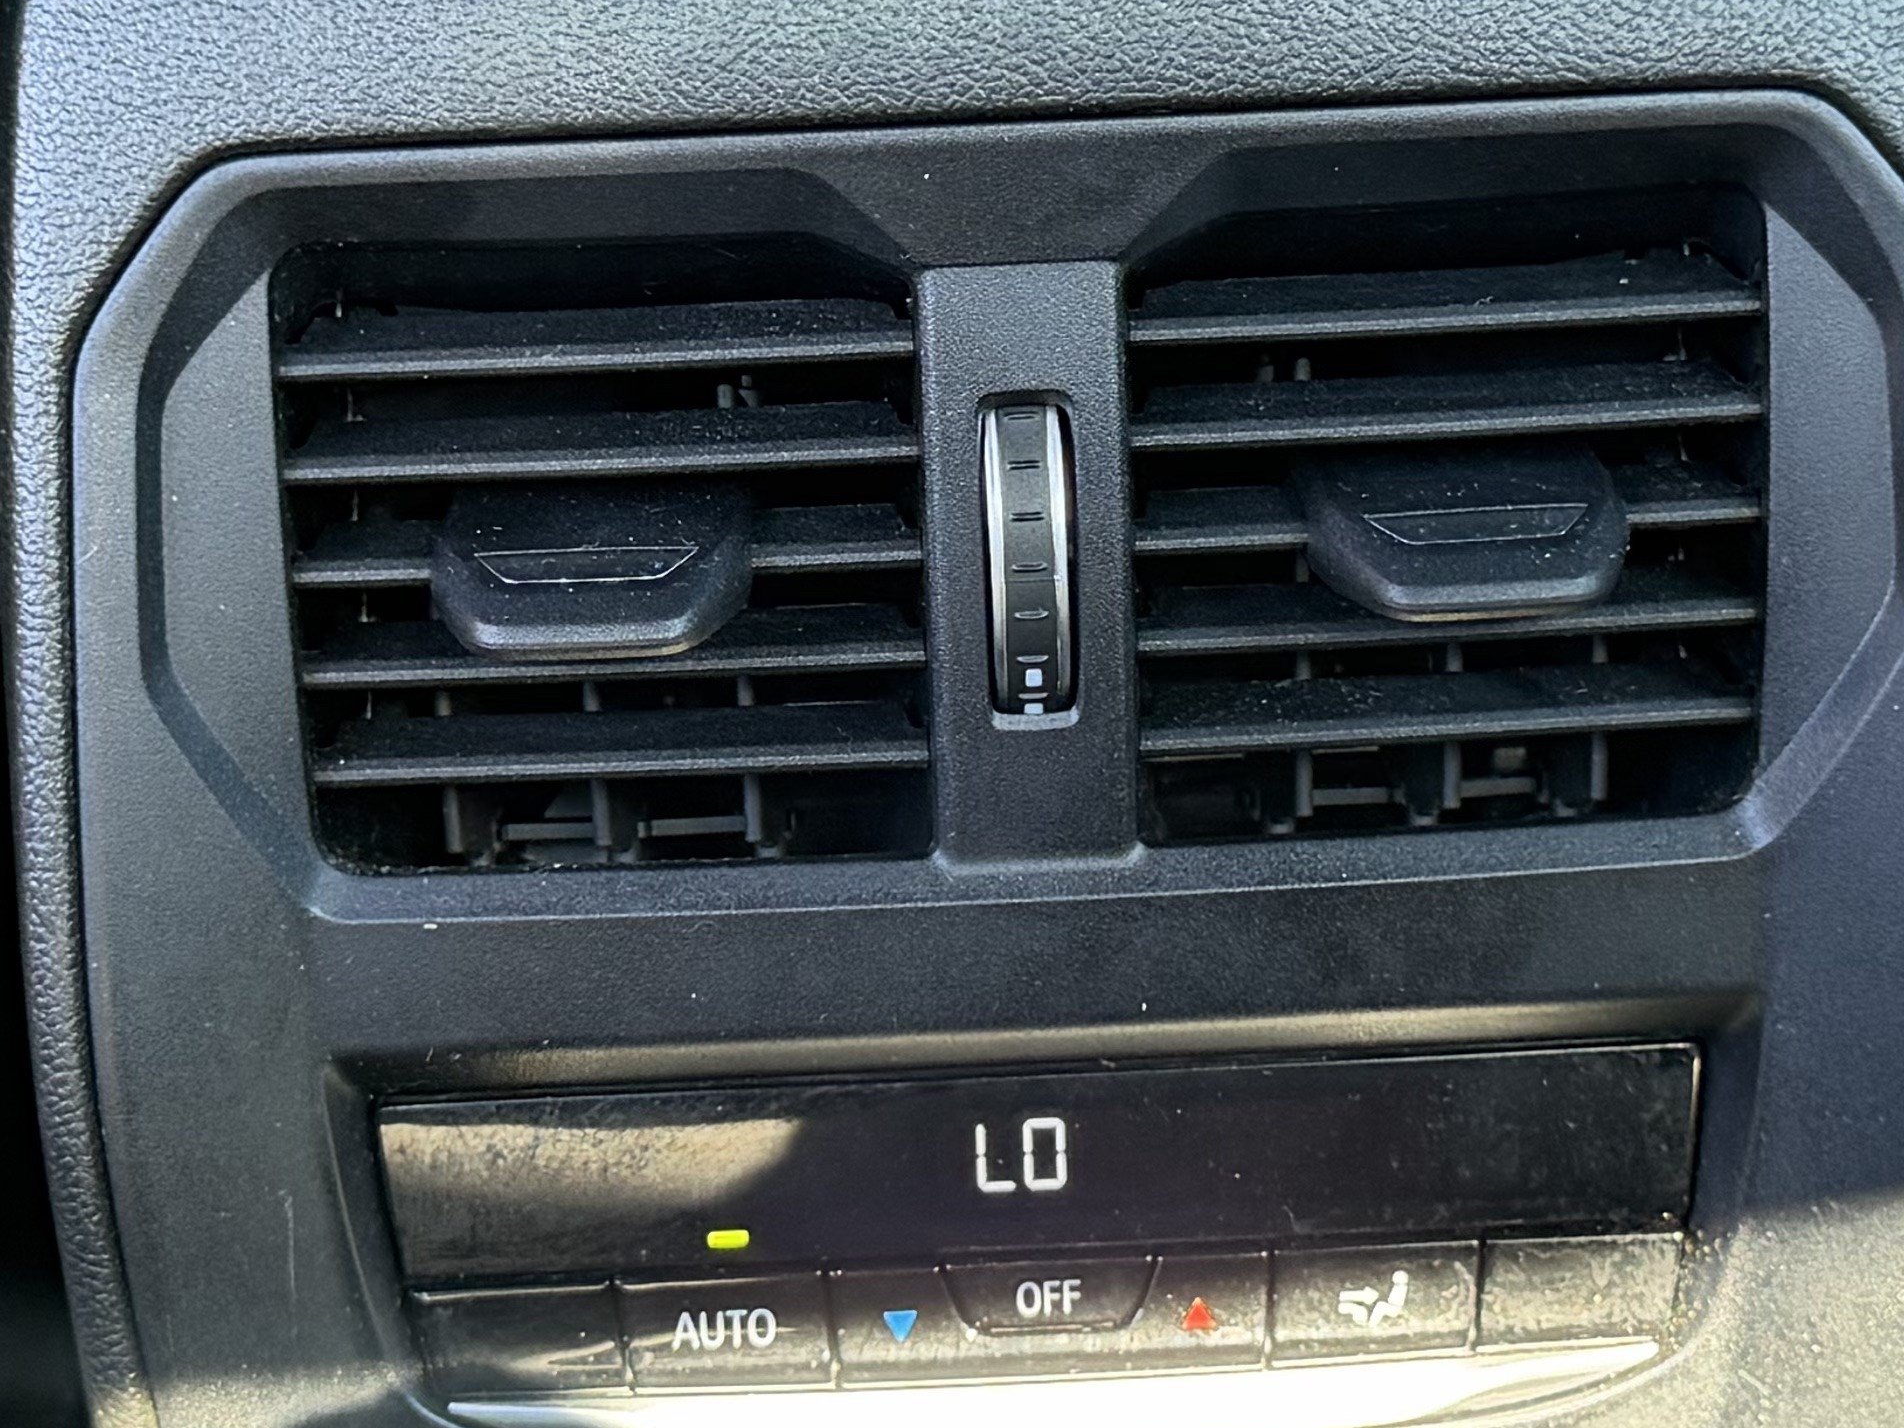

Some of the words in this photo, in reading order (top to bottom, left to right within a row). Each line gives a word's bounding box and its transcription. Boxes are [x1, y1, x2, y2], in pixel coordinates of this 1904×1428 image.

[975, 1116, 1068, 1193] LO
[1015, 1278, 1082, 1318] OFF
[671, 1308, 777, 1350] AUTO
